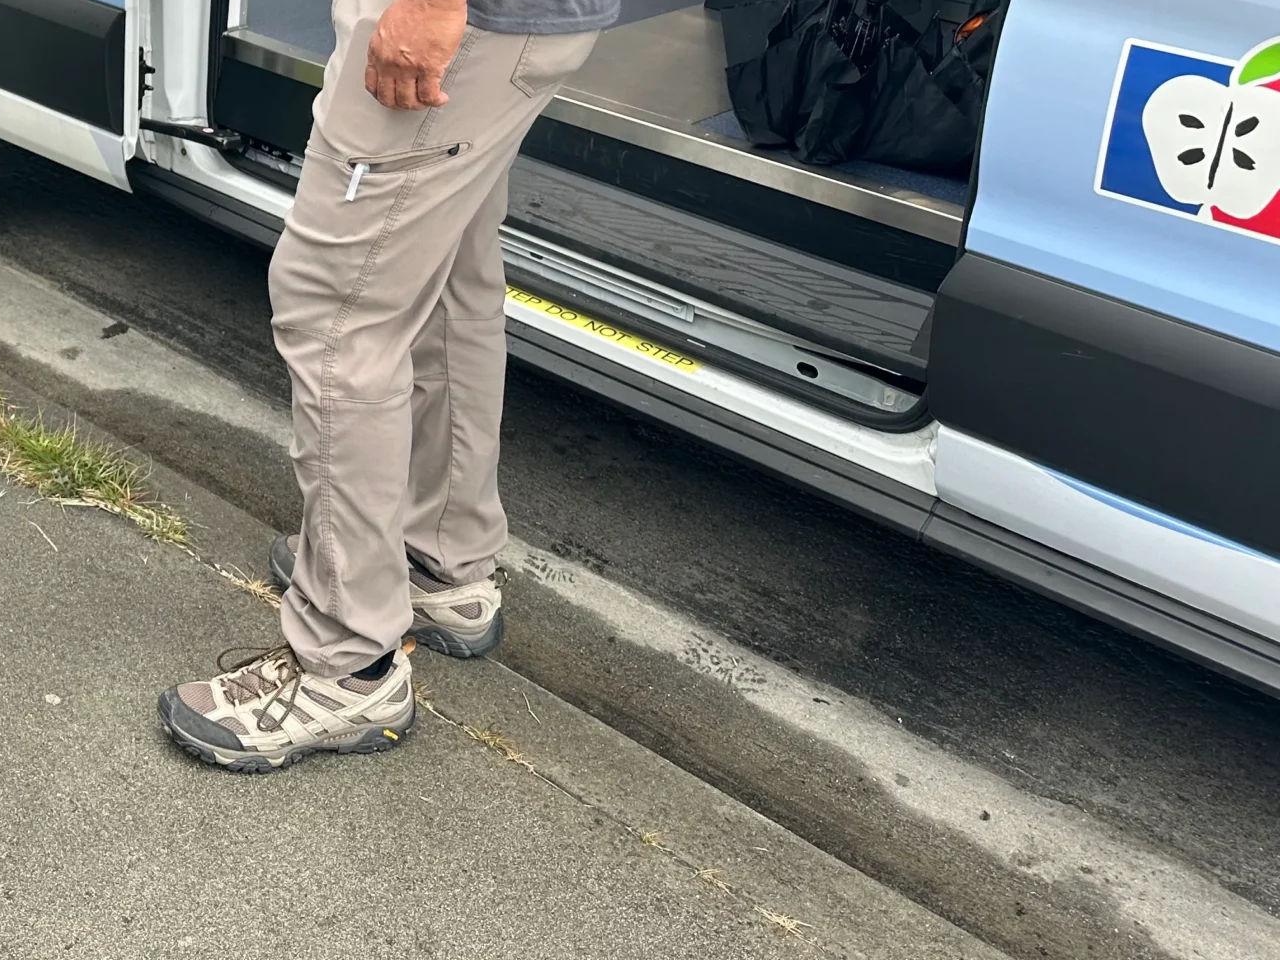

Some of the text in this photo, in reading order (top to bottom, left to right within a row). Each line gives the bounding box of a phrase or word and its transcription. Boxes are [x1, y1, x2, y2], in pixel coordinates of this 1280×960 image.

[545, 304, 578, 321] DO
[583, 320, 632, 342] NOT
[636, 342, 694, 367] STEP
